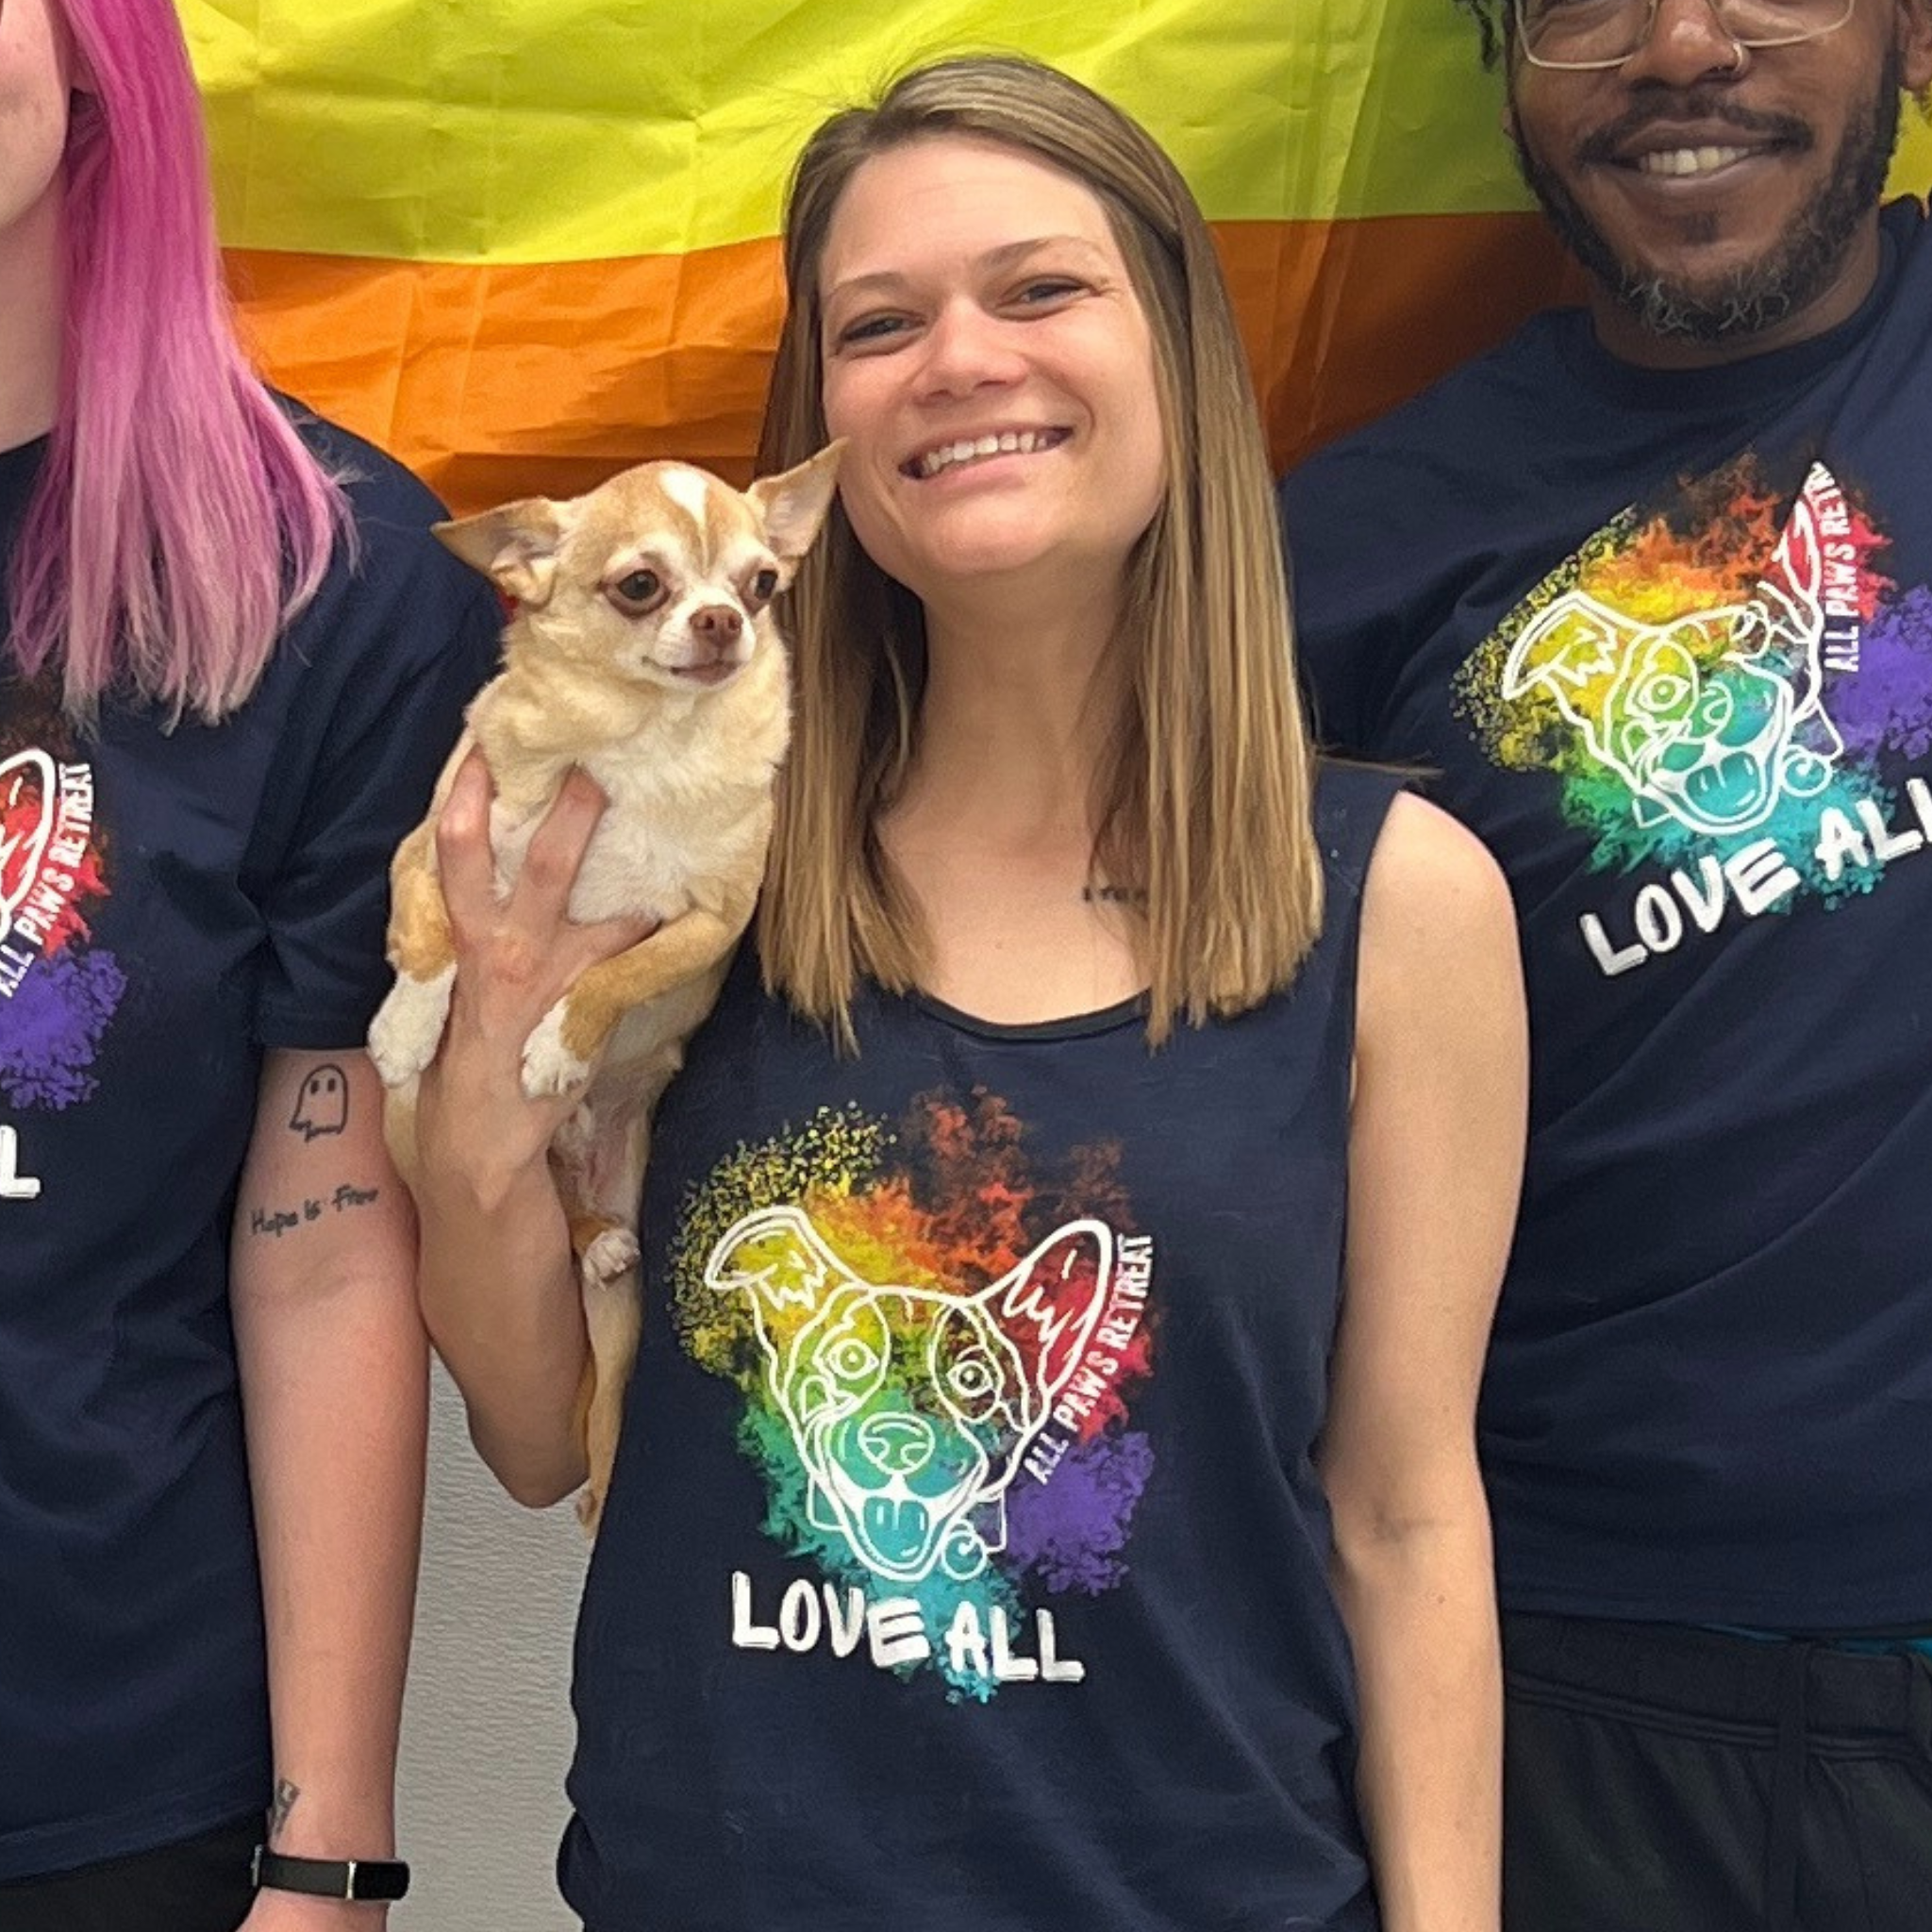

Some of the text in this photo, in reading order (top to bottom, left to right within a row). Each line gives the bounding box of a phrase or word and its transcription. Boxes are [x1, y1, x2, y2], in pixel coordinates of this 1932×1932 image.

[1824, 542, 1859, 616] PAWS
[1824, 625, 1859, 672] ALL
[13, 867, 75, 945] PAWS
[48, 763, 93, 868] RETREAT
[1579, 838, 1801, 985] LOVE
[250, 1208, 299, 1237] Hope
[1023, 1233, 1153, 1485] ALL PAWS RETREAT
[732, 1571, 1085, 1682] LOVE ALL
